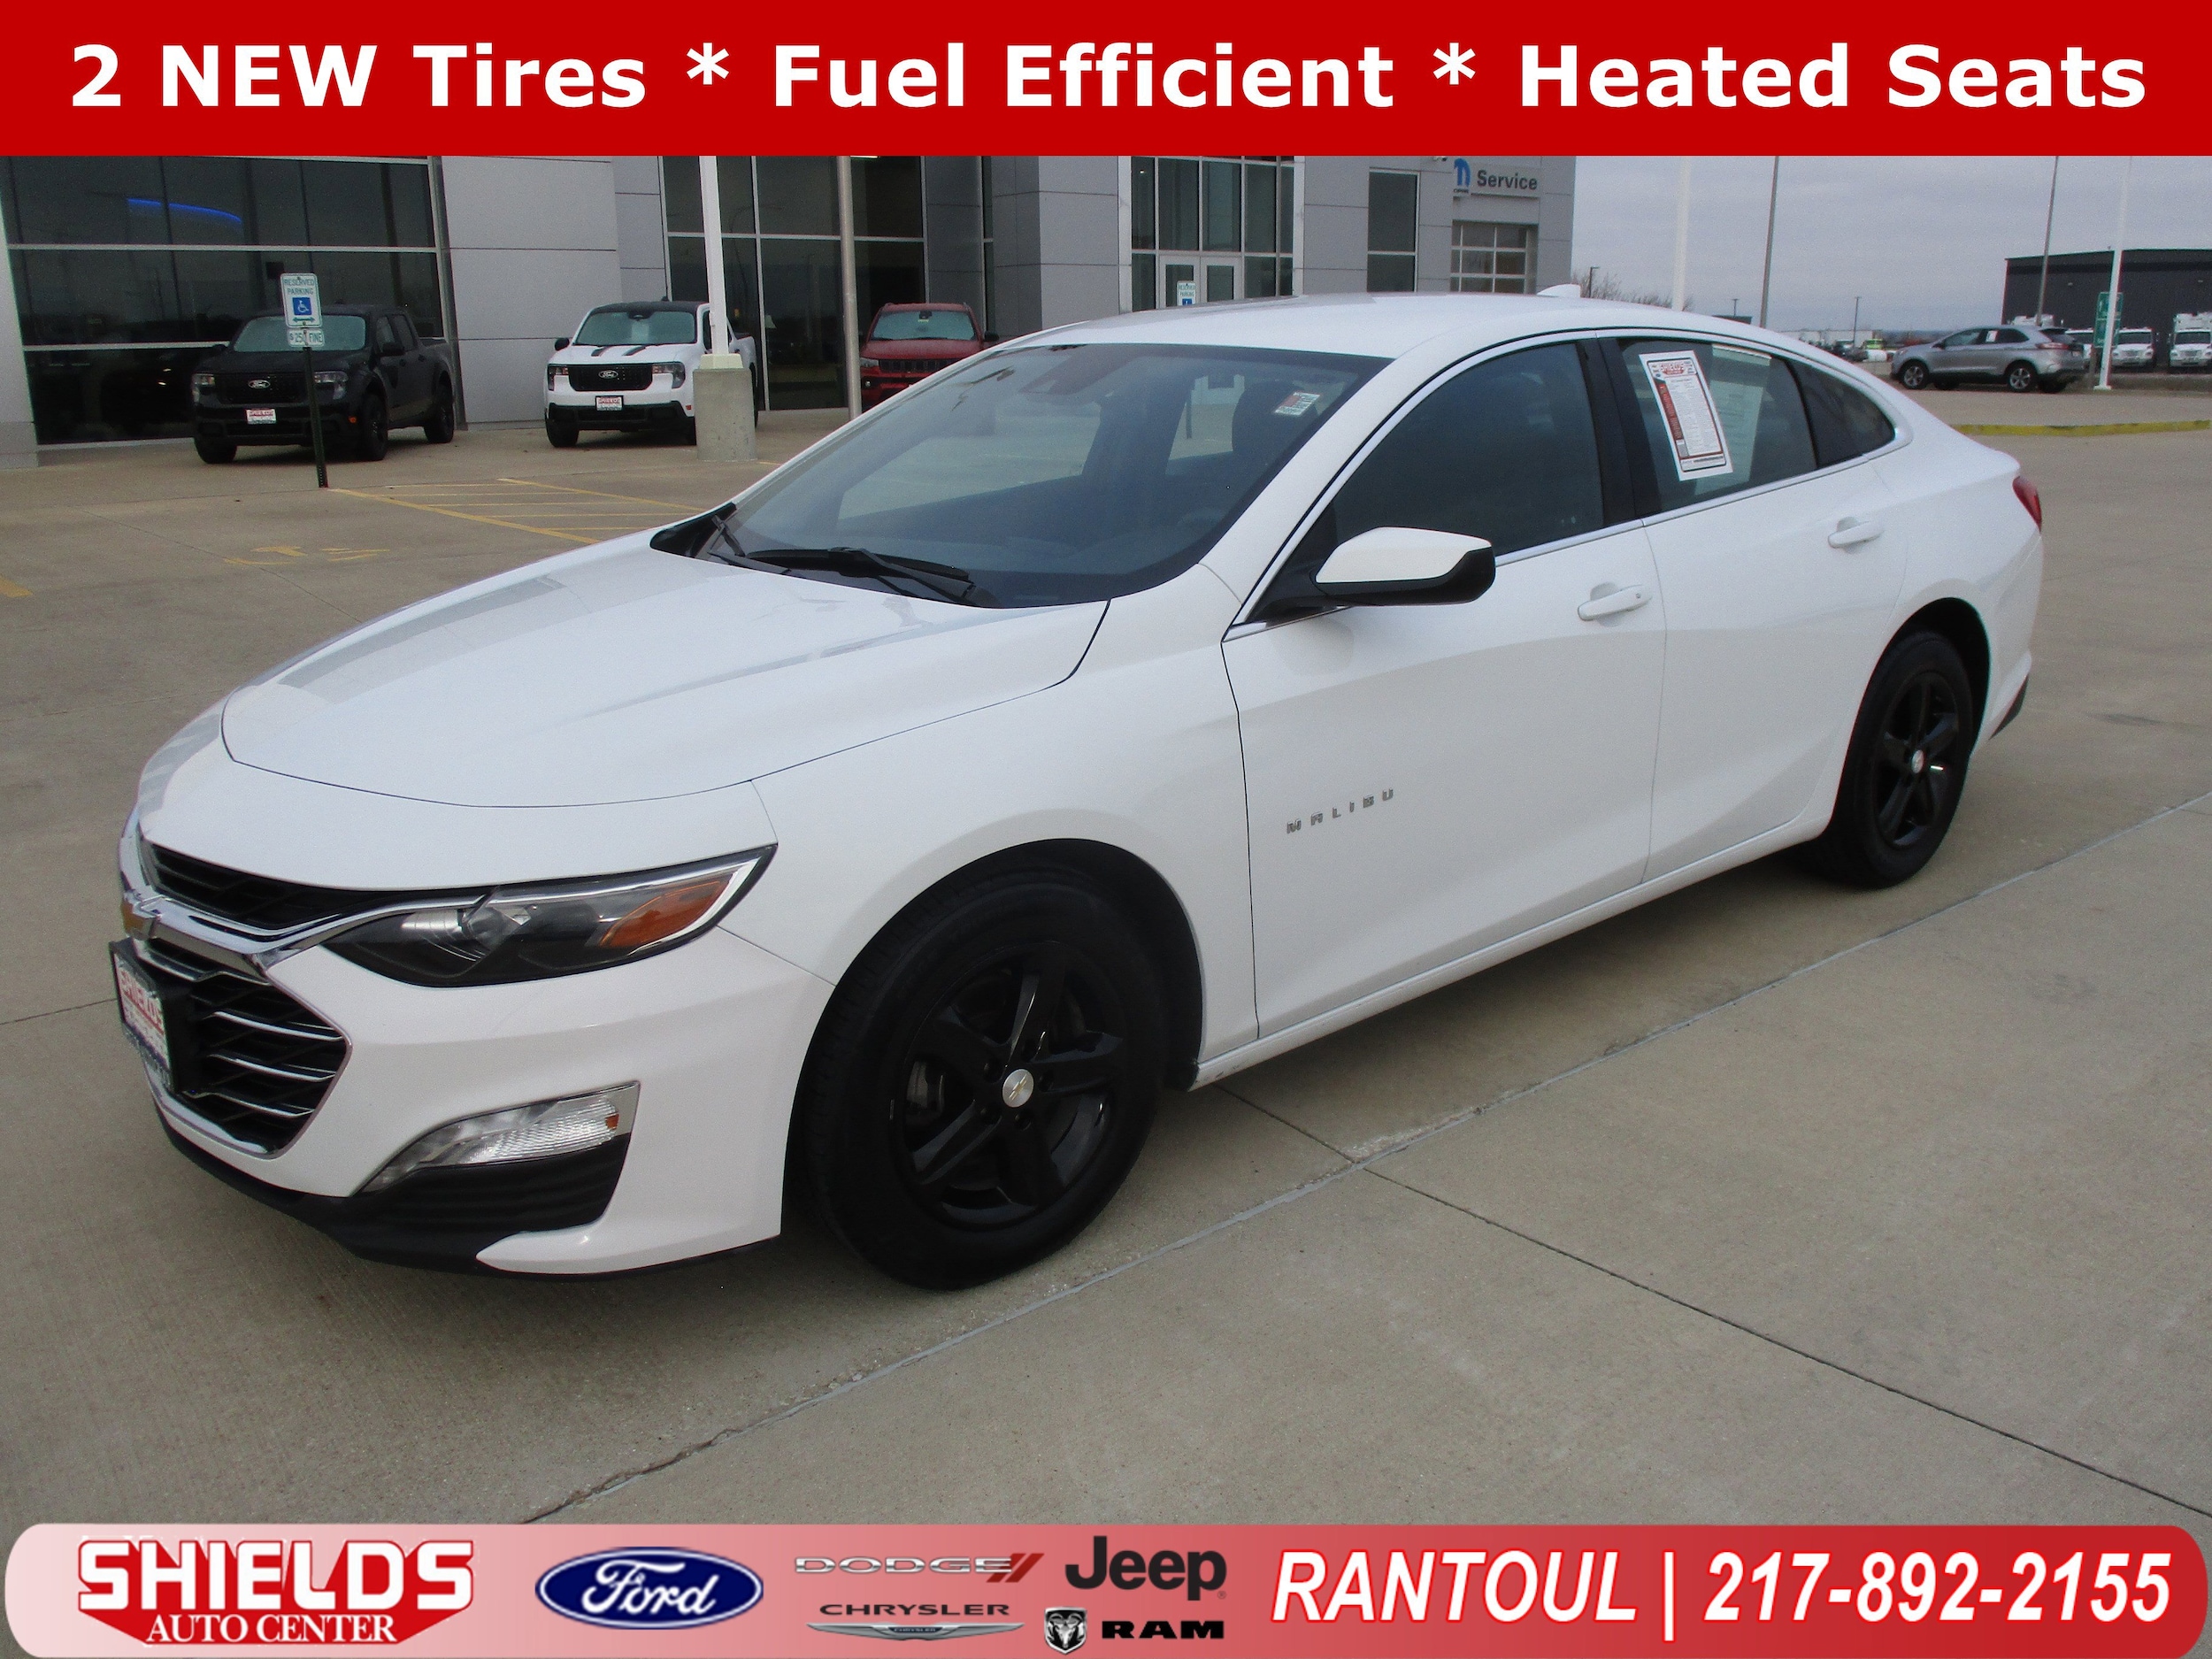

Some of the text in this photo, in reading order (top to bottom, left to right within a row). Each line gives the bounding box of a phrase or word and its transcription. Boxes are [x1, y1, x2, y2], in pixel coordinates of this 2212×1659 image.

[1477, 170, 1537, 189] Service
[309, 333, 323, 342] FINE
[1286, 787, 1394, 834] MALIBU
